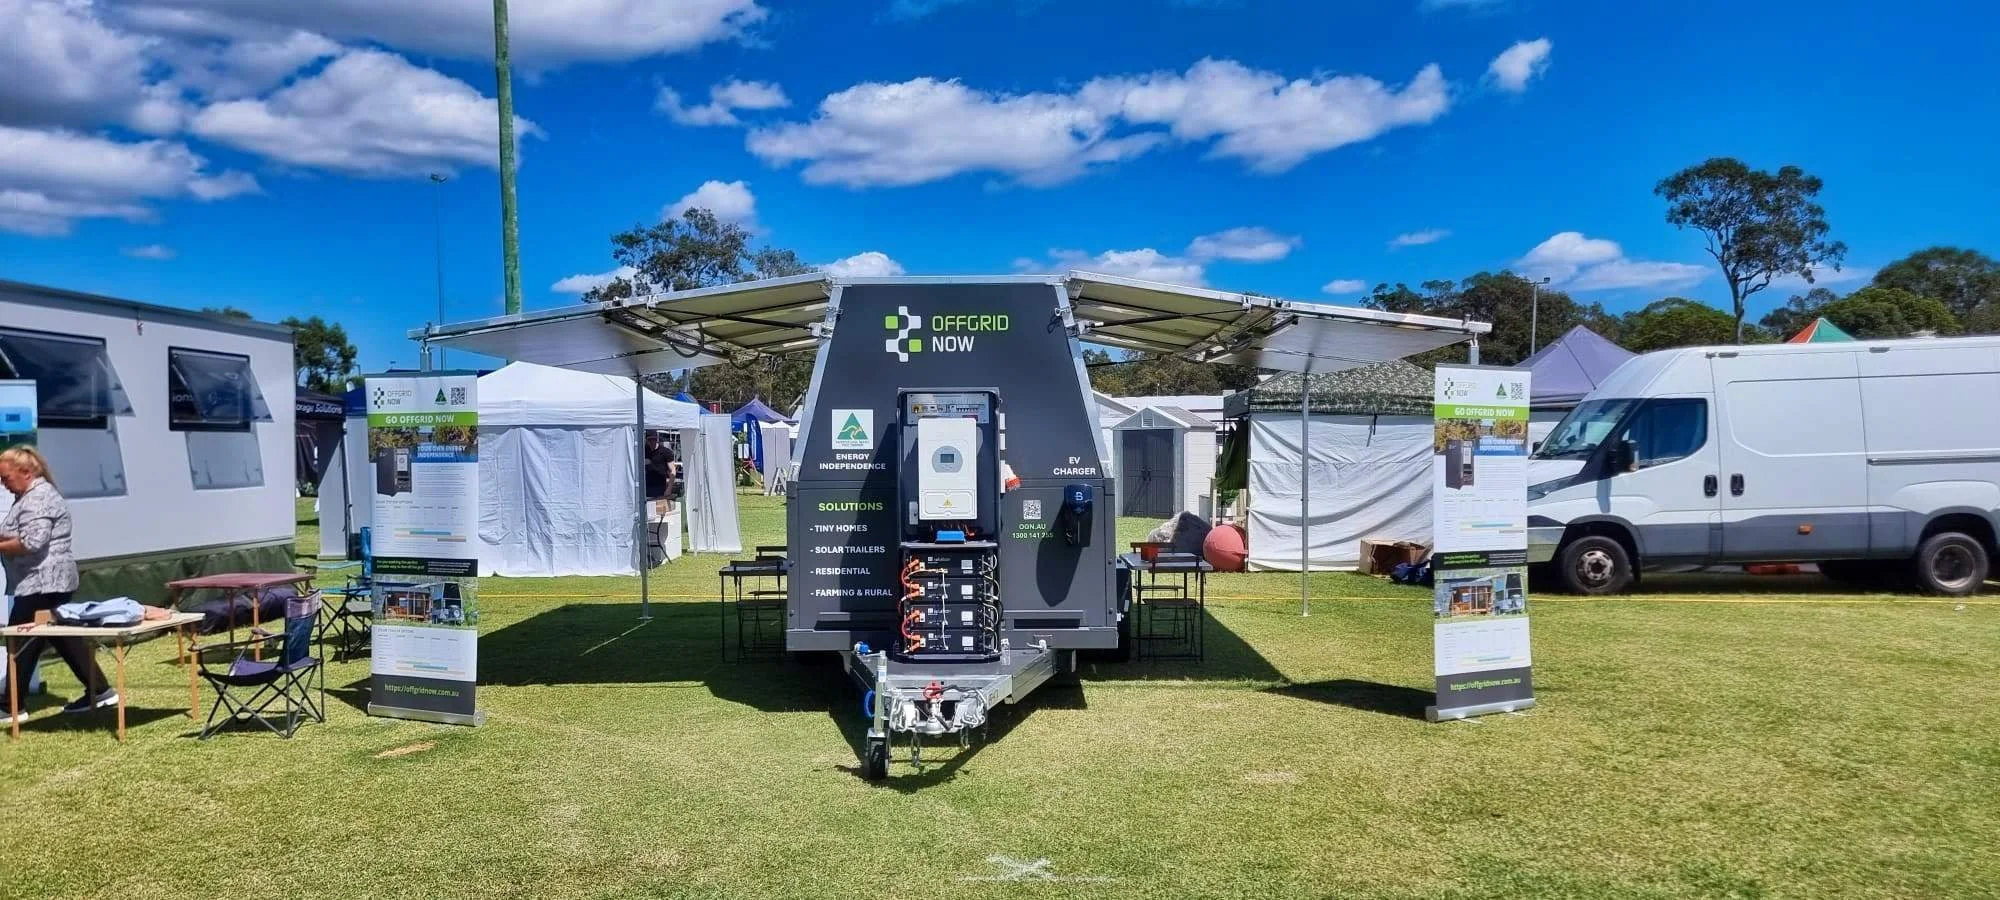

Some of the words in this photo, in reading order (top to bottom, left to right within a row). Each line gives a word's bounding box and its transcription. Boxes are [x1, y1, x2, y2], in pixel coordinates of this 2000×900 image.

[932, 315, 1009, 331] OFFGRID
[932, 336, 974, 352] NOW
[1455, 407, 1465, 416] GO
[1466, 408, 1495, 416] OFFGRID
[1496, 408, 1515, 417] NOW
[385, 415, 397, 424] GO
[399, 415, 434, 424] OFFGRID
[435, 415, 455, 423] NOW
[1068, 456, 1080, 464] EV
[1053, 467, 1096, 475] CHARGER
[818, 502, 884, 511] SOLUTIONS
[814, 524, 834, 532] TINY
[836, 524, 868, 532] HOMES
[844, 545, 886, 553] TRAILERS
[815, 567, 871, 575] RESIDENTIAL
[815, 589, 855, 597] FARMING
[864, 588, 893, 596] RURAL
[384, 683, 459, 696] https://offgridnow.com.au
